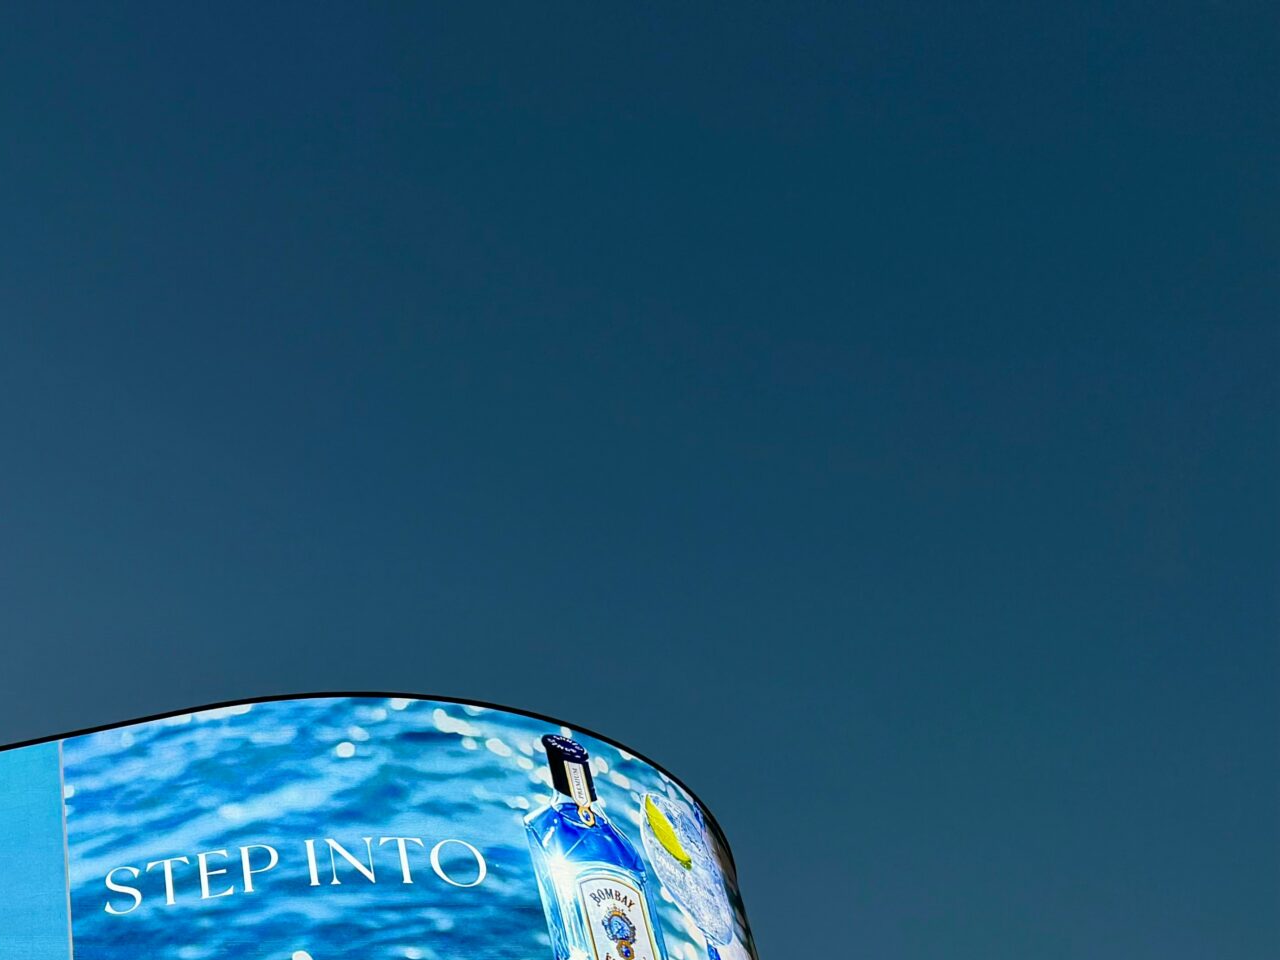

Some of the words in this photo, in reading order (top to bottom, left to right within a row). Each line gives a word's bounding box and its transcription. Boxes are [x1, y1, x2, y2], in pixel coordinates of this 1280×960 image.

[105, 845, 279, 915] STEP
[305, 837, 487, 887] INTO
[589, 888, 635, 909] BOMBAY
